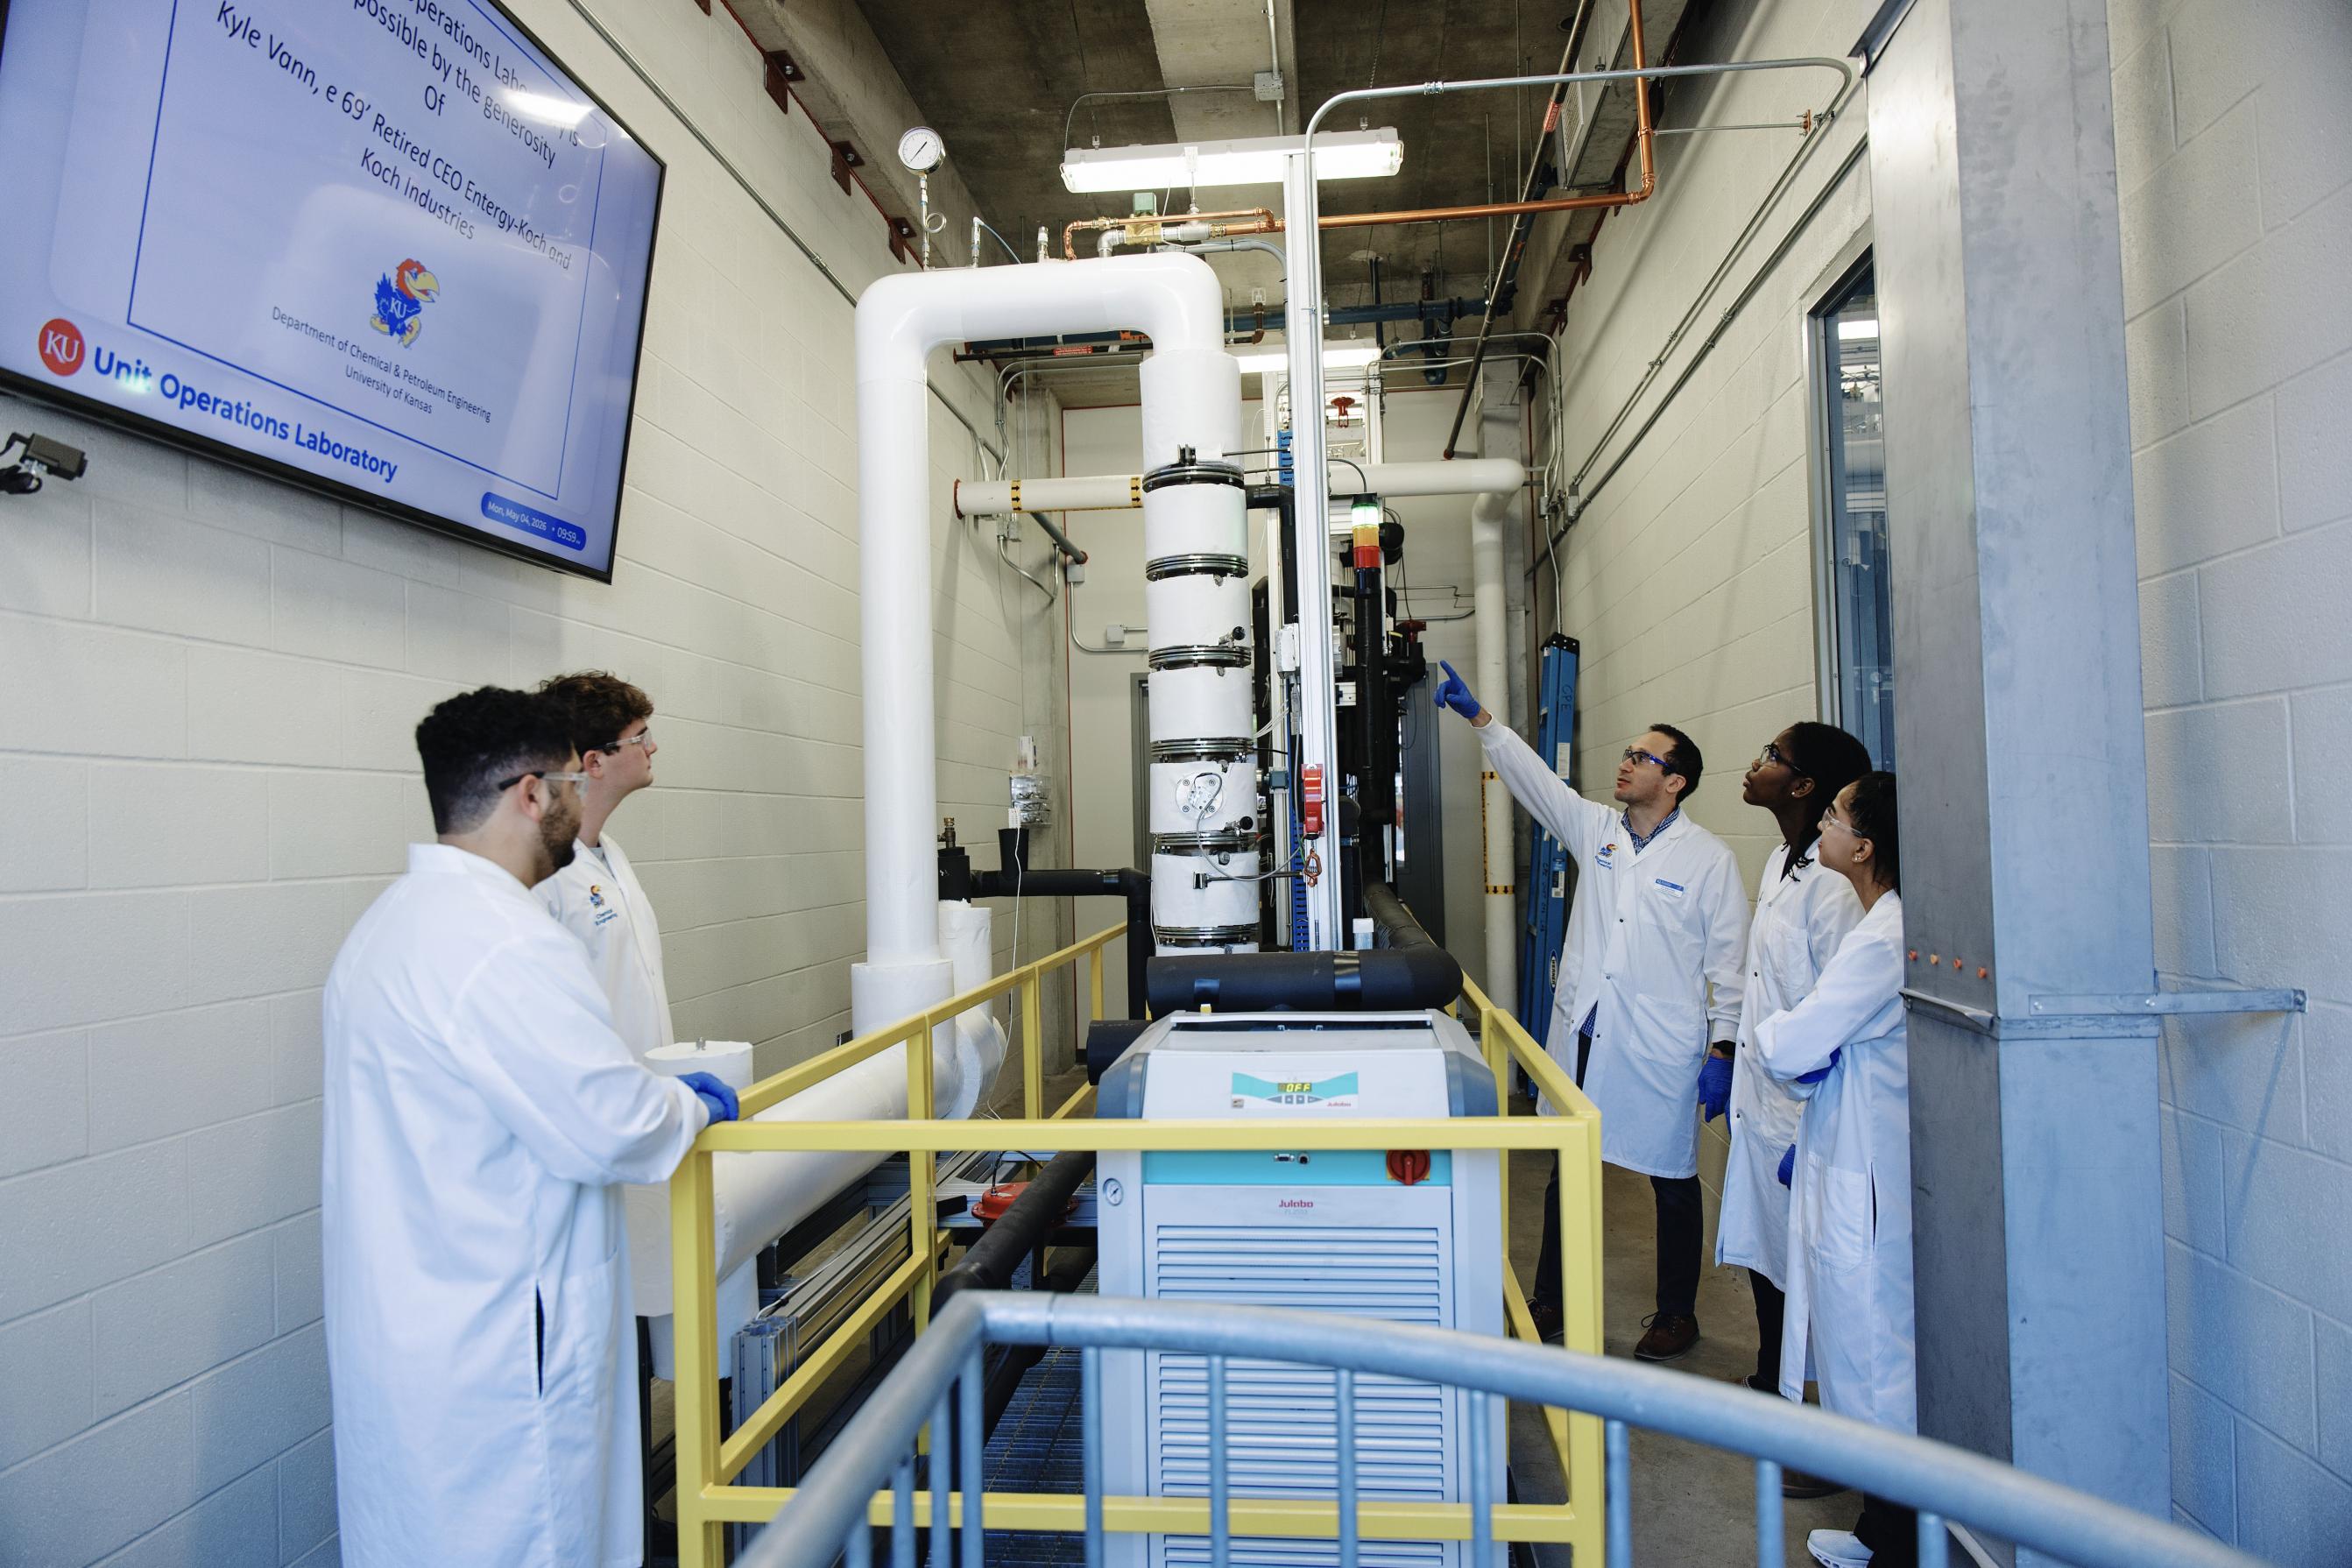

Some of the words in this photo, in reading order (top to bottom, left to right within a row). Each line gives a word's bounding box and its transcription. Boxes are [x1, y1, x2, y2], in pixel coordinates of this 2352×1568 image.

[408, 0, 491, 68] perations
[425, 85, 445, 117] Of
[432, 43, 452, 82] by
[456, 66, 481, 103] the
[484, 96, 556, 169] generosity
[217, 0, 261, 48] Kyle
[269, 34, 319, 95] Vann,
[326, 85, 338, 102] e
[372, 113, 430, 169] Retired
[433, 157, 463, 191] CEO
[464, 180, 547, 253] Entergy-Koch
[548, 244, 572, 271] and
[361, 147, 400, 190] Koch
[404, 177, 475, 240] Industries
[391, 298, 407, 319] KU
[45, 329, 81, 364] KU
[272, 306, 335, 348] Department
[337, 340, 348, 352] of
[350, 344, 392, 374] Chemical
[393, 364, 401, 378] &
[403, 370, 445, 398] Petroleum
[447, 391, 491, 423] Engineering
[345, 364, 391, 398] University
[393, 388, 404, 401] of
[404, 392, 433, 414] Kansas
[95, 347, 152, 392] Unit
[159, 373, 288, 440] Operations
[294, 423, 398, 483] Laboratory
[487, 500, 505, 517] Mon,
[505, 508, 519, 522] May
[520, 513, 530, 526] 04,
[532, 518, 547, 531] 2026
[557, 527, 576, 543] 09:59
[1286, 1083, 1311, 1093] OFF
[1278, 1198, 1314, 1208] Julabo
